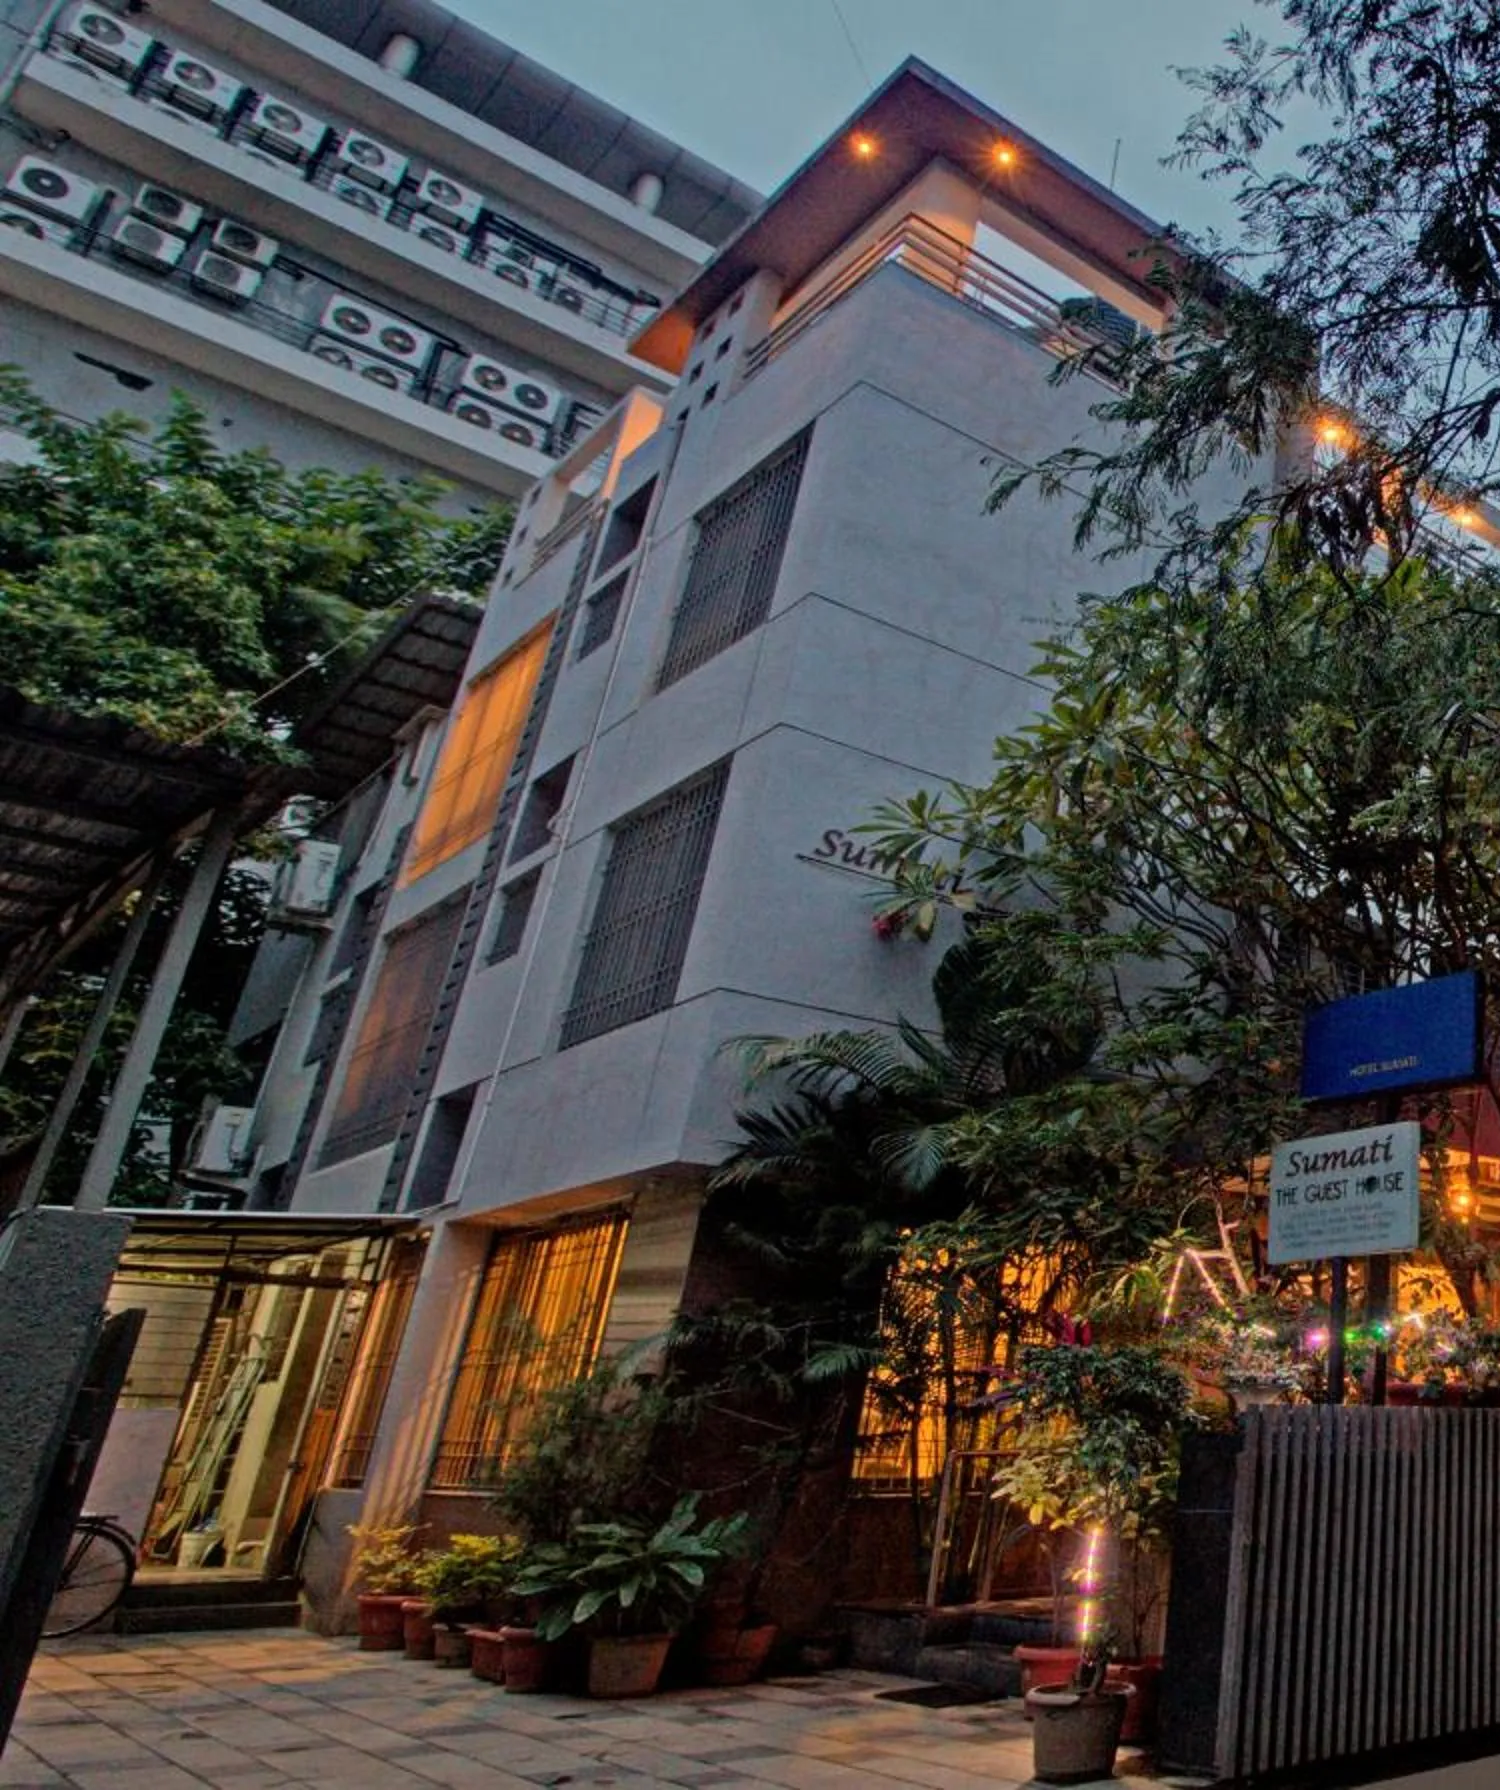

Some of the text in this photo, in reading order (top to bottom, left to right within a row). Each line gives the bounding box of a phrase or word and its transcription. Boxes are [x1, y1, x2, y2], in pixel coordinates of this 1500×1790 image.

[1285, 1134, 1394, 1177] Sumati
[1275, 1171, 1405, 1207] THE GUEST HOUSE
